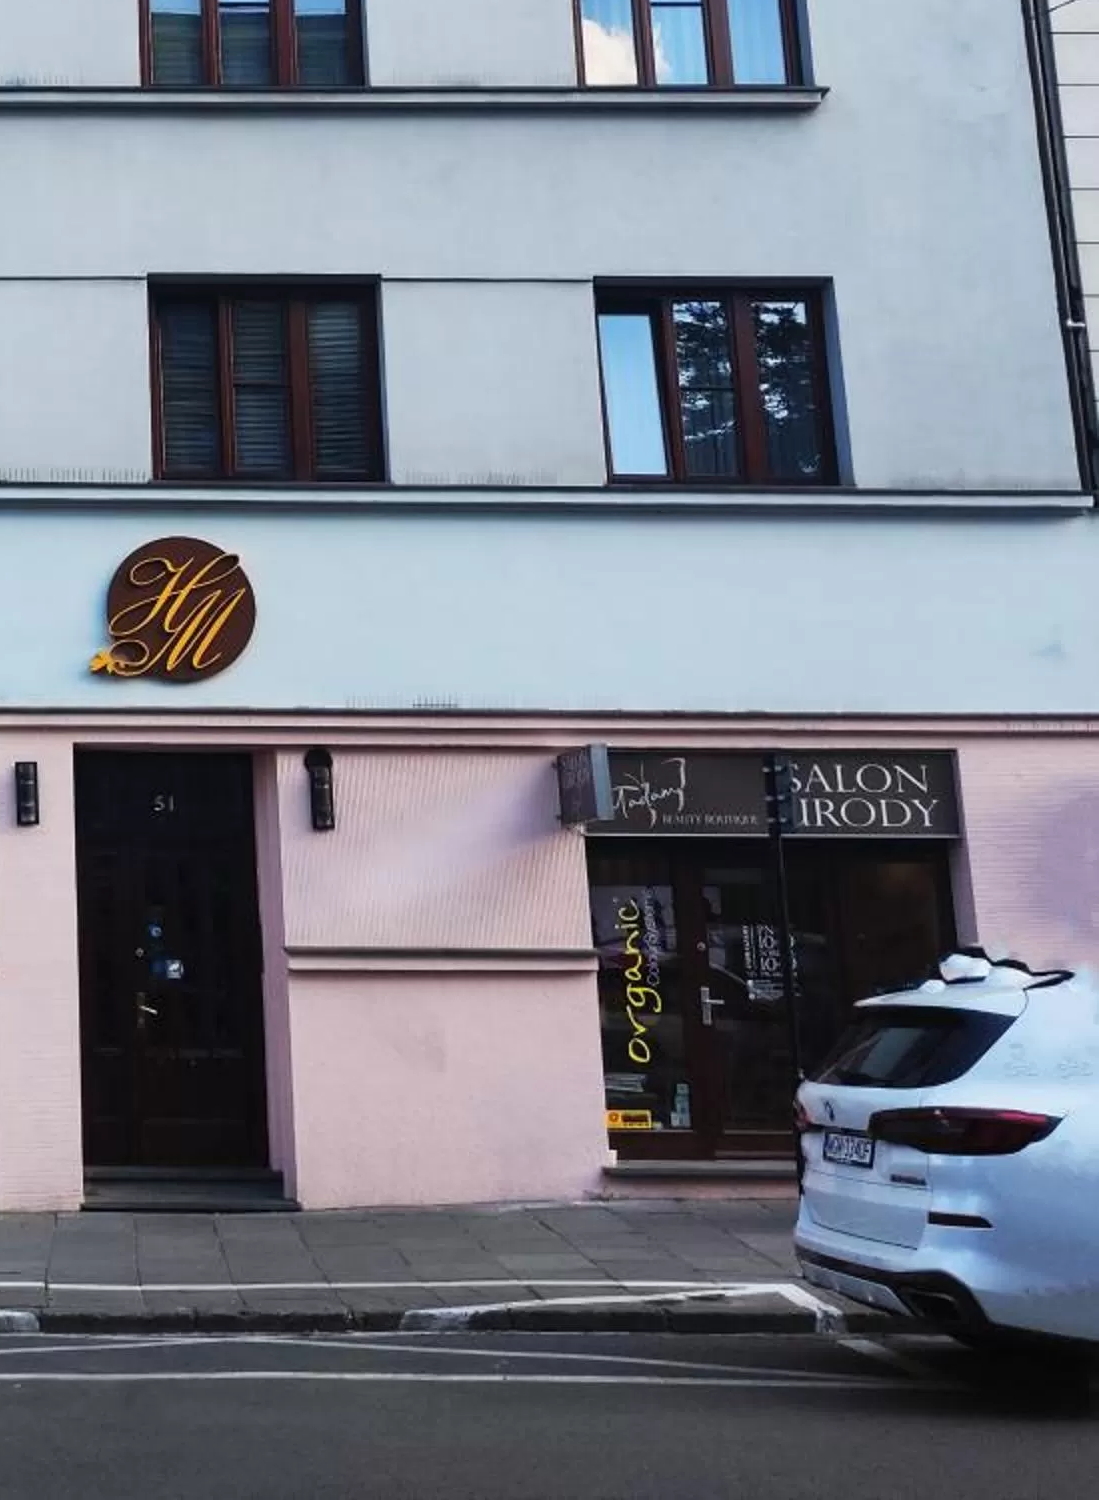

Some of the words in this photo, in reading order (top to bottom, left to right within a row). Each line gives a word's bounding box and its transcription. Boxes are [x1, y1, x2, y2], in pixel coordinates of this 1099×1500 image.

[789, 763, 929, 794] SALON
[153, 794, 175, 813] 51
[615, 898, 662, 1064] organic
